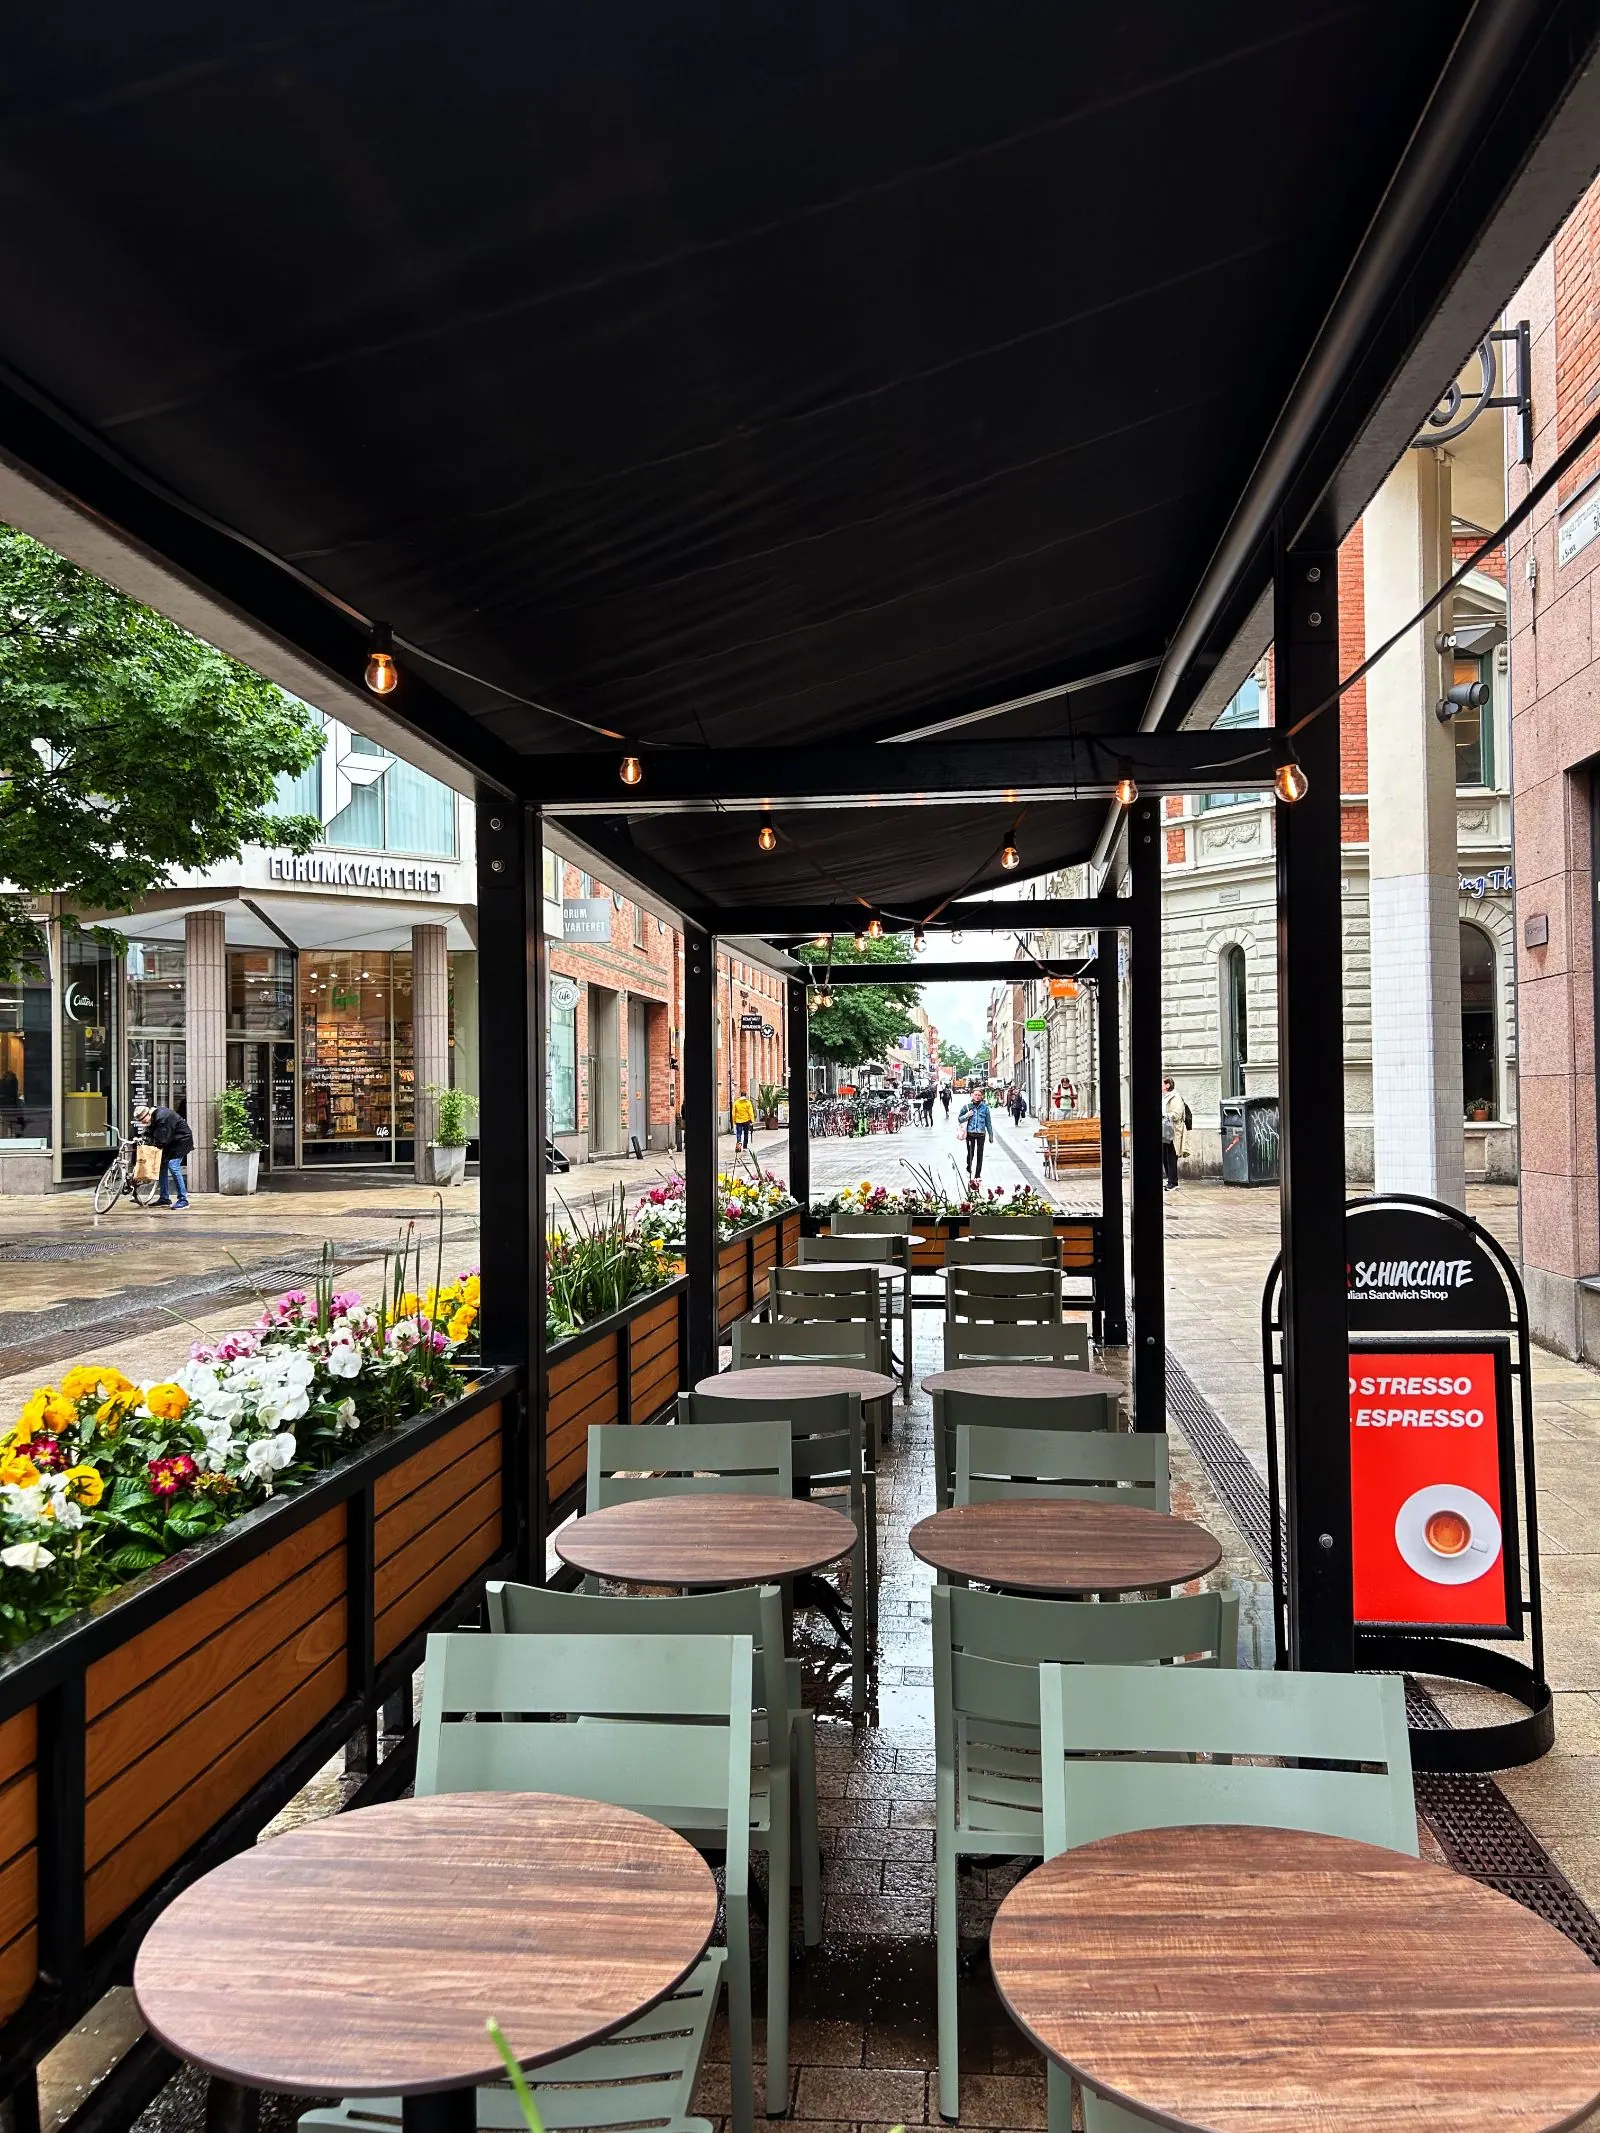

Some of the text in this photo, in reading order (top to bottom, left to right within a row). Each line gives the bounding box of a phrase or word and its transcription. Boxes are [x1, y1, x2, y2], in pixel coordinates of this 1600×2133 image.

[269, 856, 444, 893] FORUMKVARTERET
[1487, 866, 1513, 890] Th
[563, 908, 588, 920] ORUM
[562, 921, 605, 933] VARTERET
[376, 1126, 390, 1138] life
[1355, 1259, 1474, 1288] SCHIACCIATE
[1369, 1289, 1419, 1300] Sandwich
[1420, 1289, 1448, 1301] Shop
[1359, 1376, 1473, 1396] STRESSO
[1355, 1408, 1484, 1428] ESPRESSO
